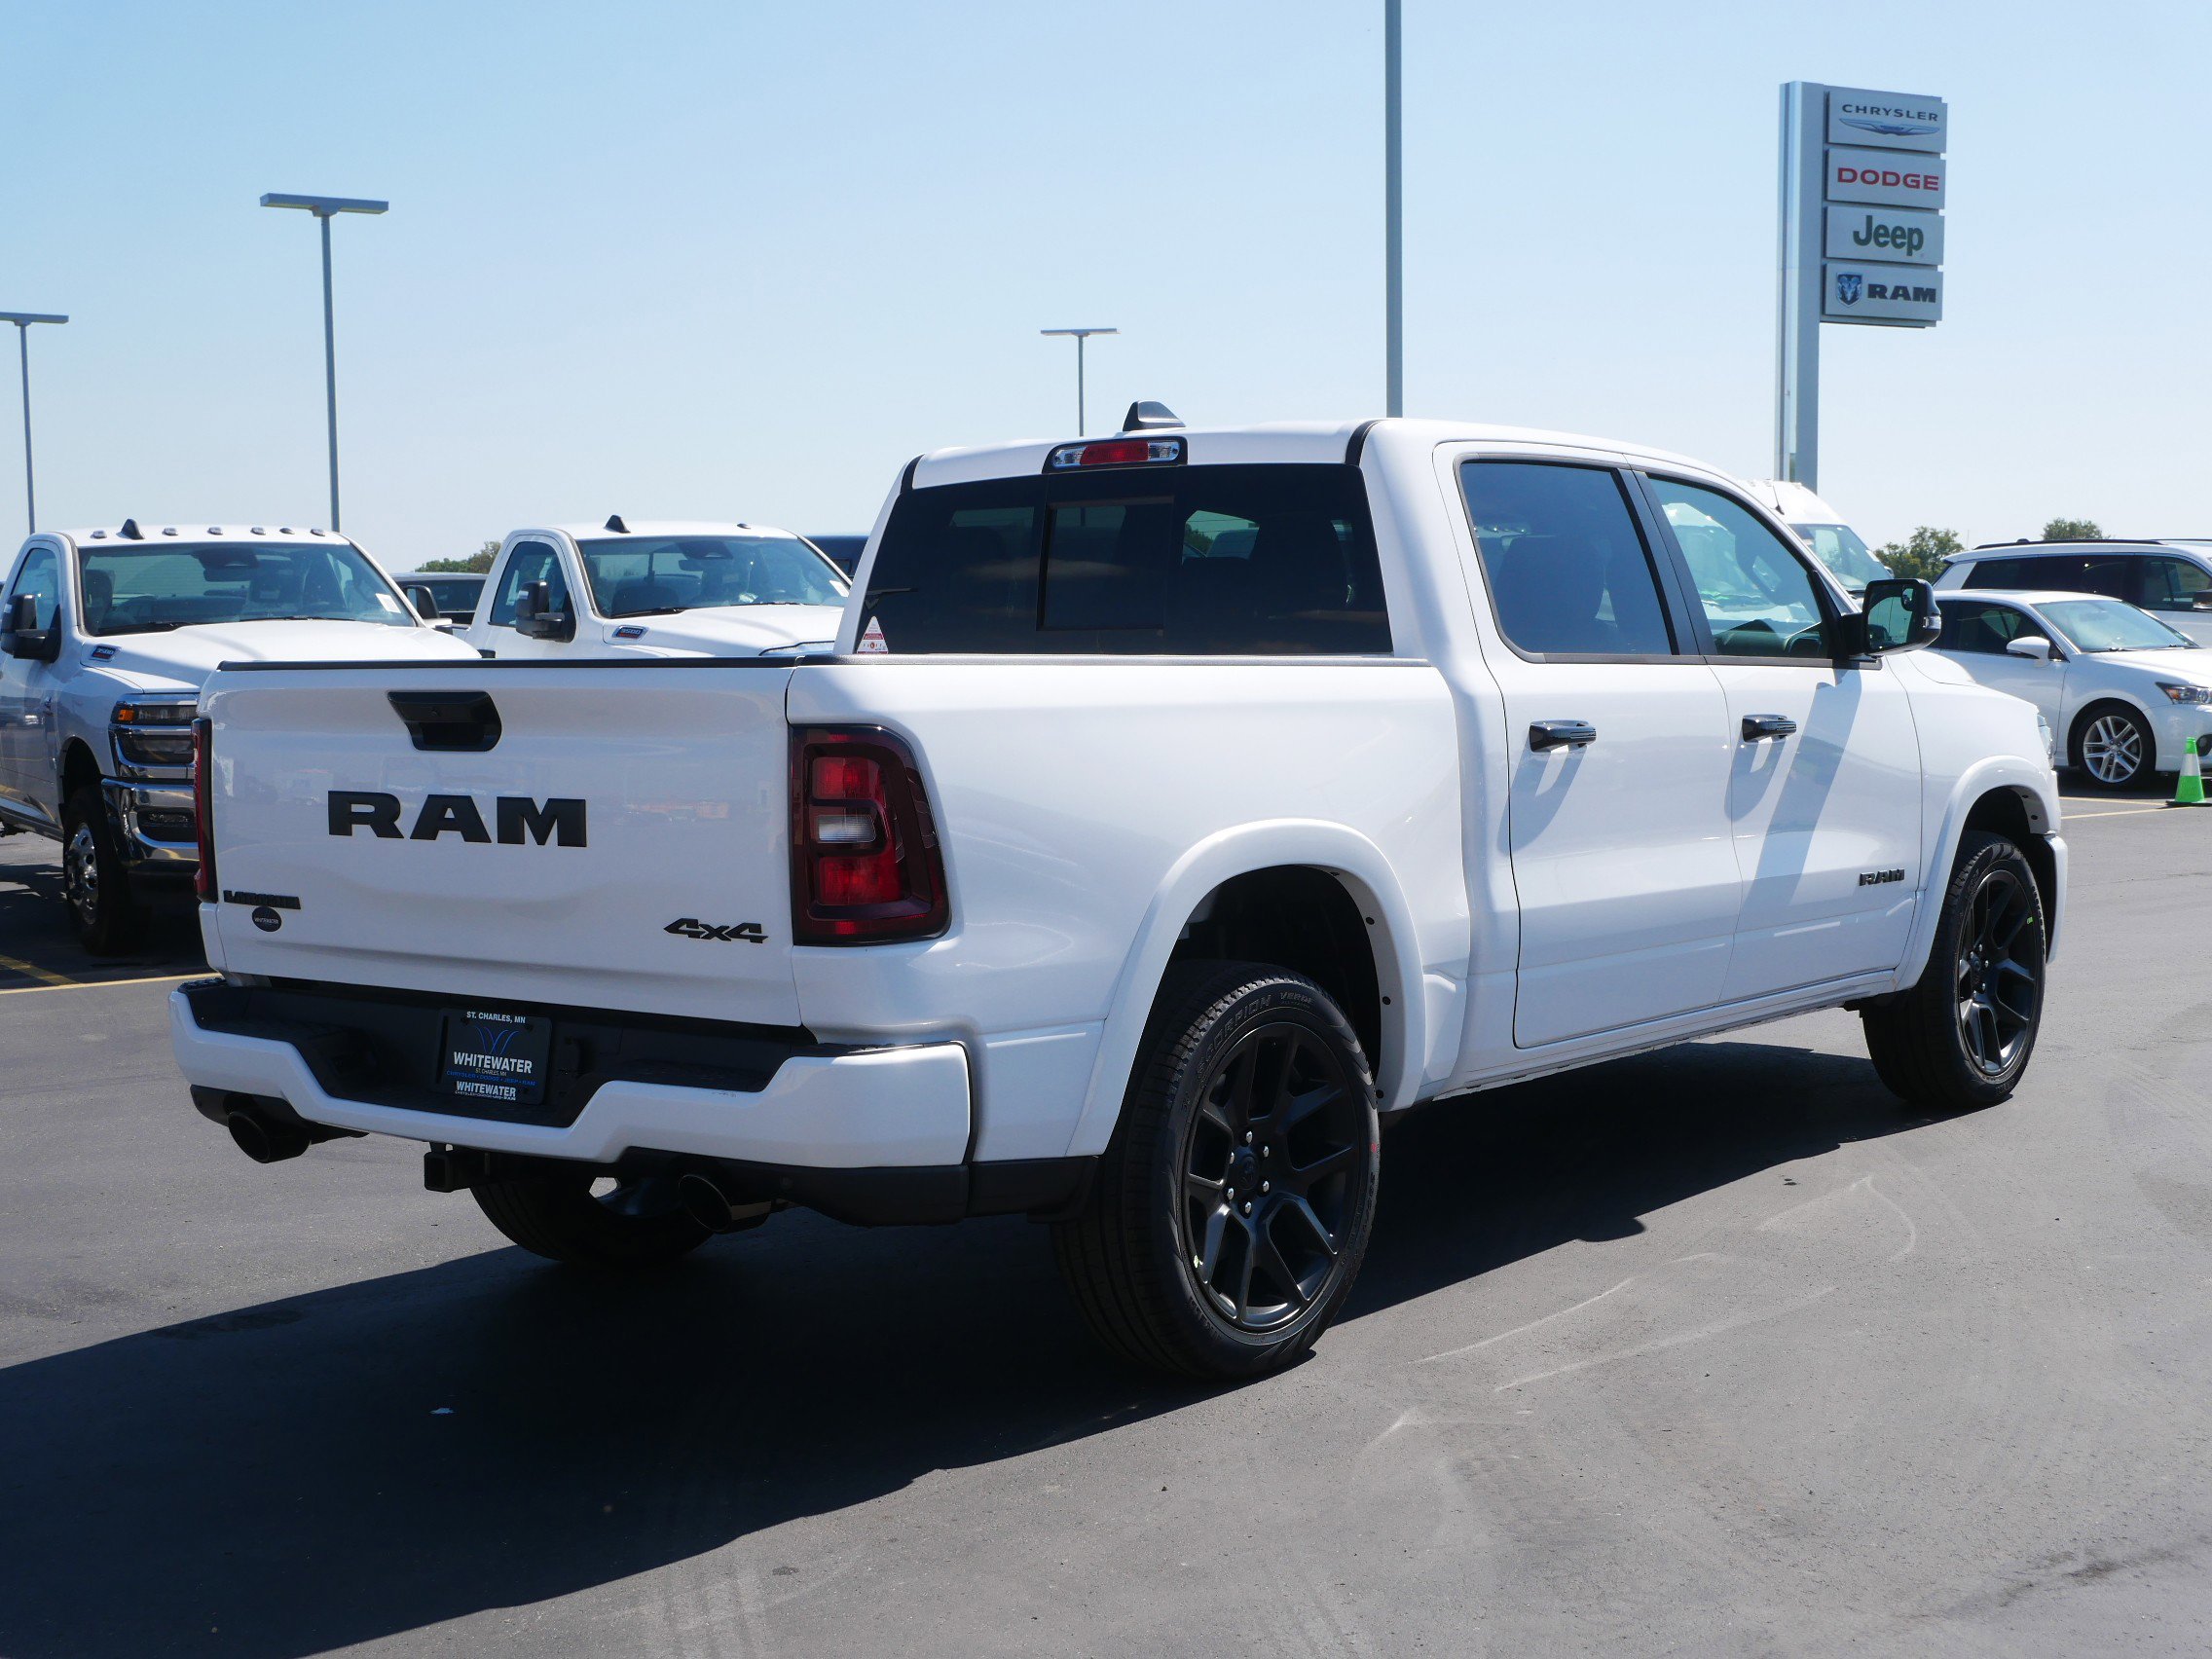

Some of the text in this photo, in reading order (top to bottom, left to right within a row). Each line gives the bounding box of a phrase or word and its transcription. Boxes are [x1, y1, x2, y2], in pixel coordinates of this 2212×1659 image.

[1842, 104, 1938, 122] CHRYSLER
[1837, 167, 1939, 191] DODGE
[1853, 215, 1924, 256] Jeep
[1867, 283, 1936, 303] RAM
[327, 790, 587, 848] RAM
[1859, 868, 1905, 886] RAM
[663, 917, 769, 944] 4x4
[466, 1011, 526, 1024] ST. CHARLES, MN
[453, 1051, 533, 1074] WHITEWATER
[456, 1081, 517, 1098] WHITEWATER
